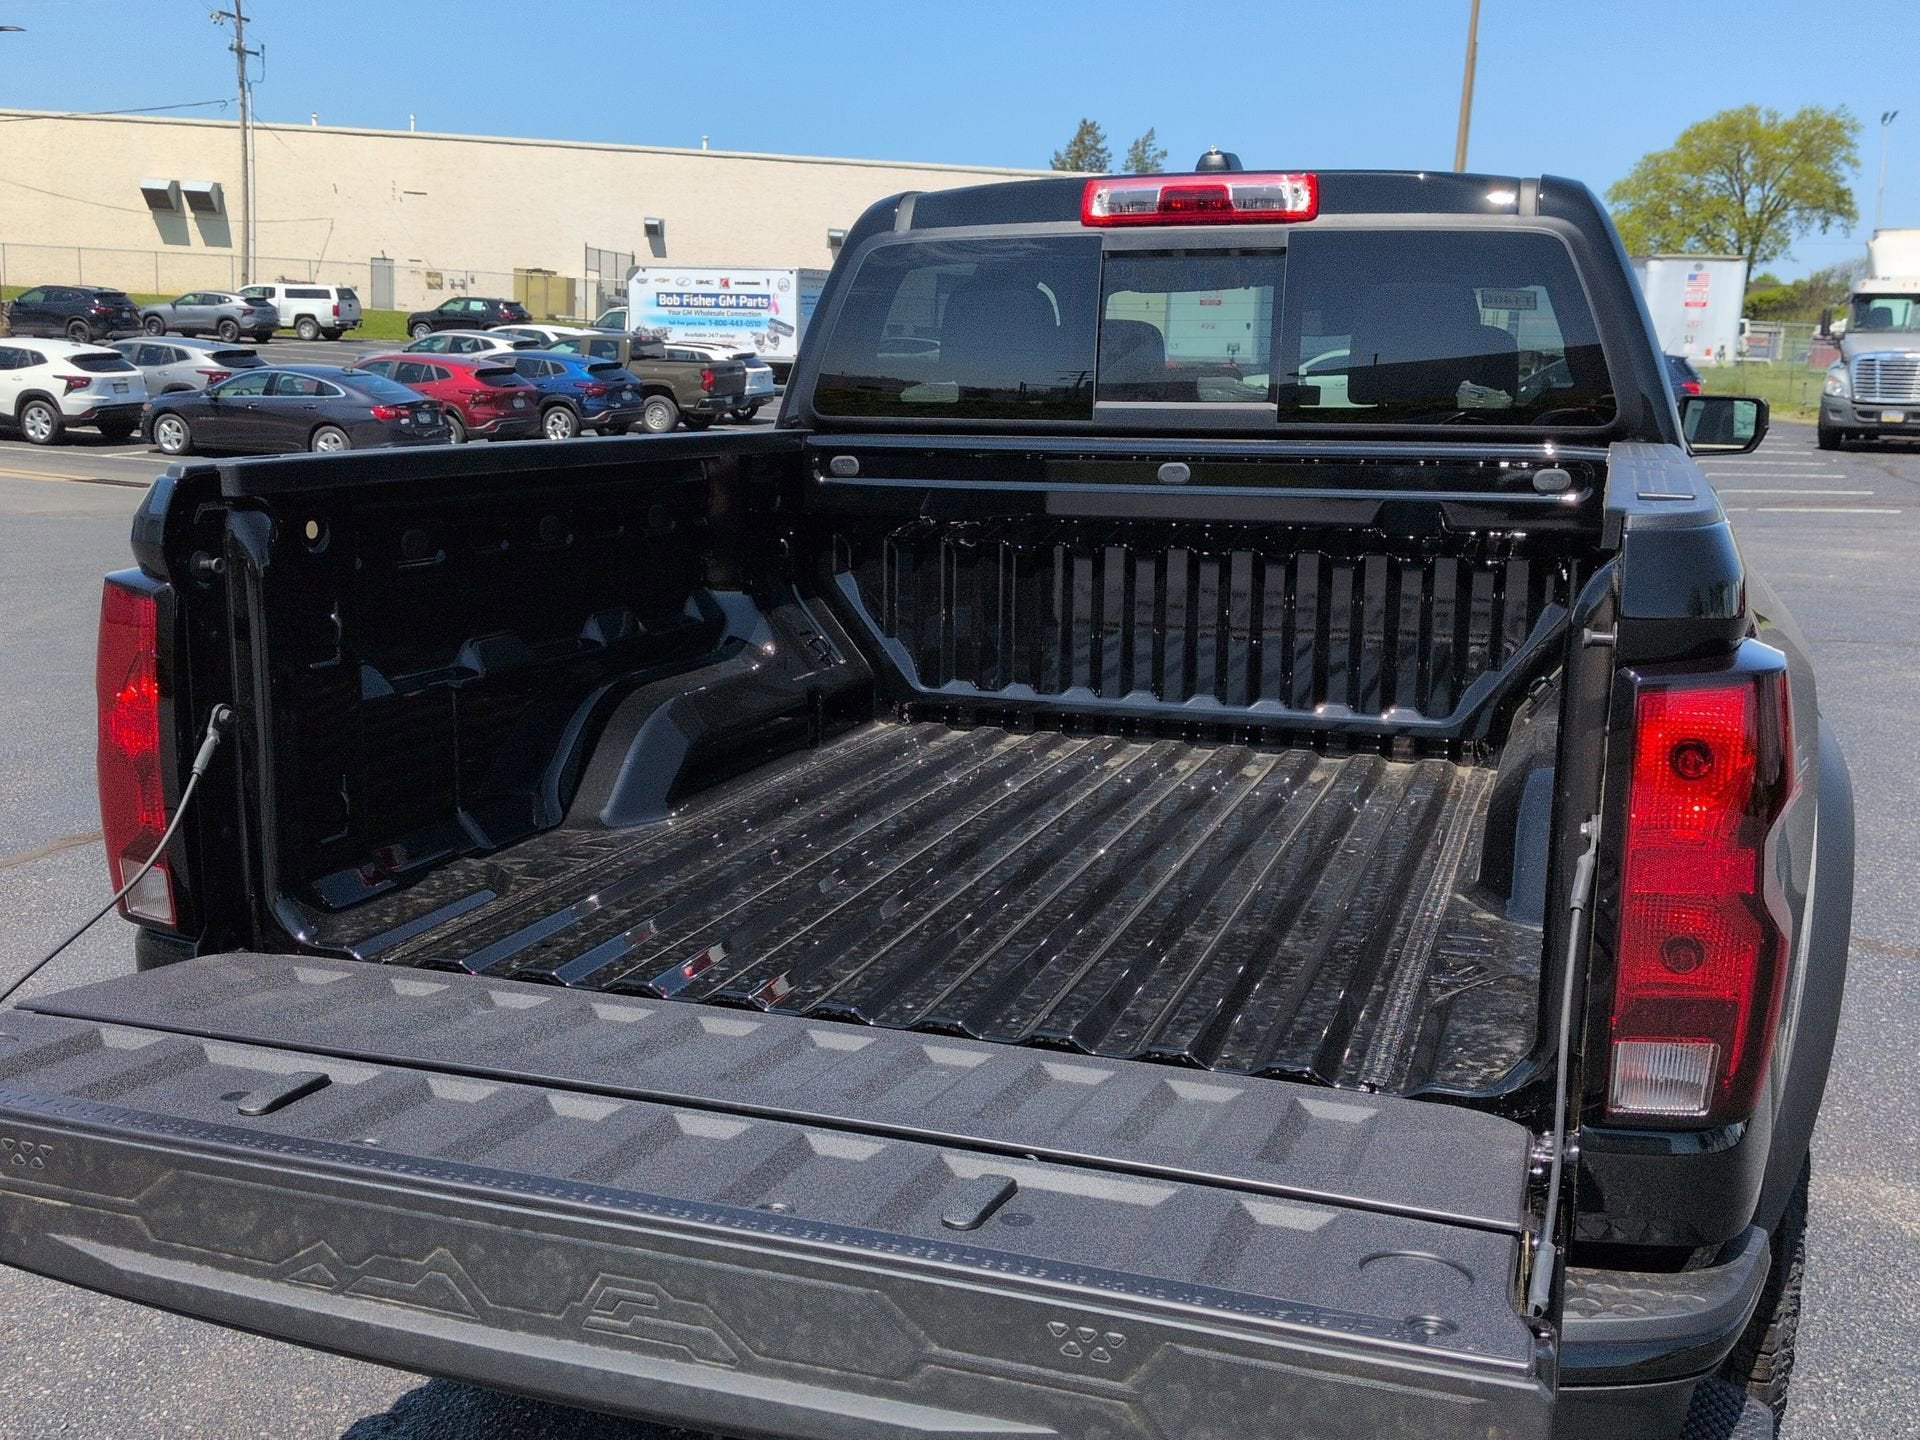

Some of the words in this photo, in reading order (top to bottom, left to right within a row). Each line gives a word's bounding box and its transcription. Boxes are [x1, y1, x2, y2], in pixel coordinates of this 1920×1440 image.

[658, 294, 680, 306] Bob
[682, 294, 716, 307] Fisher
[718, 294, 737, 307] GM
[739, 295, 769, 308] Parts
[694, 309, 725, 317] Wholesale
[726, 310, 762, 318] Connection
